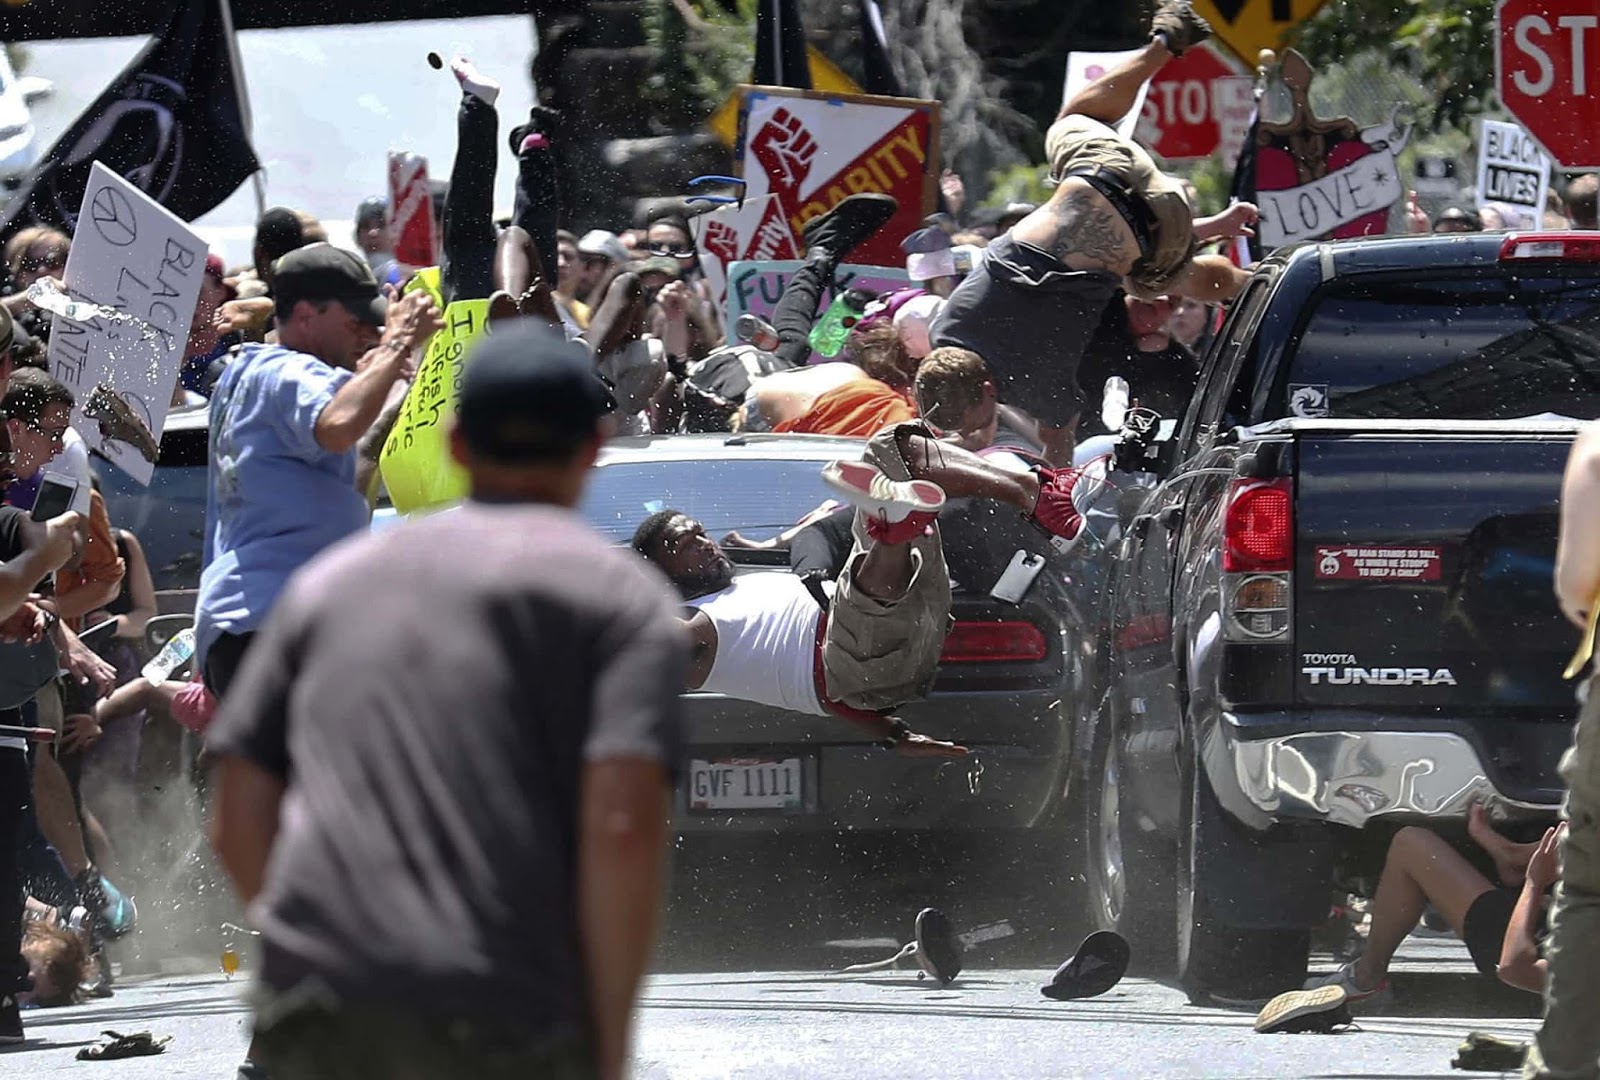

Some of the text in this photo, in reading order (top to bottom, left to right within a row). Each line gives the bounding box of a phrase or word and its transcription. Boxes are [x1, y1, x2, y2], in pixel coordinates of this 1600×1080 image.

[1513, 15, 1599, 96] ST
[1271, 168, 1373, 236] LOVE
[1487, 167, 1538, 204] LIVES
[754, 214, 790, 260] arity
[141, 238, 195, 352] BLACK
[735, 269, 857, 311] FUK
[1302, 653, 1357, 664] TOYOTA
[1302, 667, 1458, 685] TUNDRA
[695, 767, 793, 797] GVF 1111
